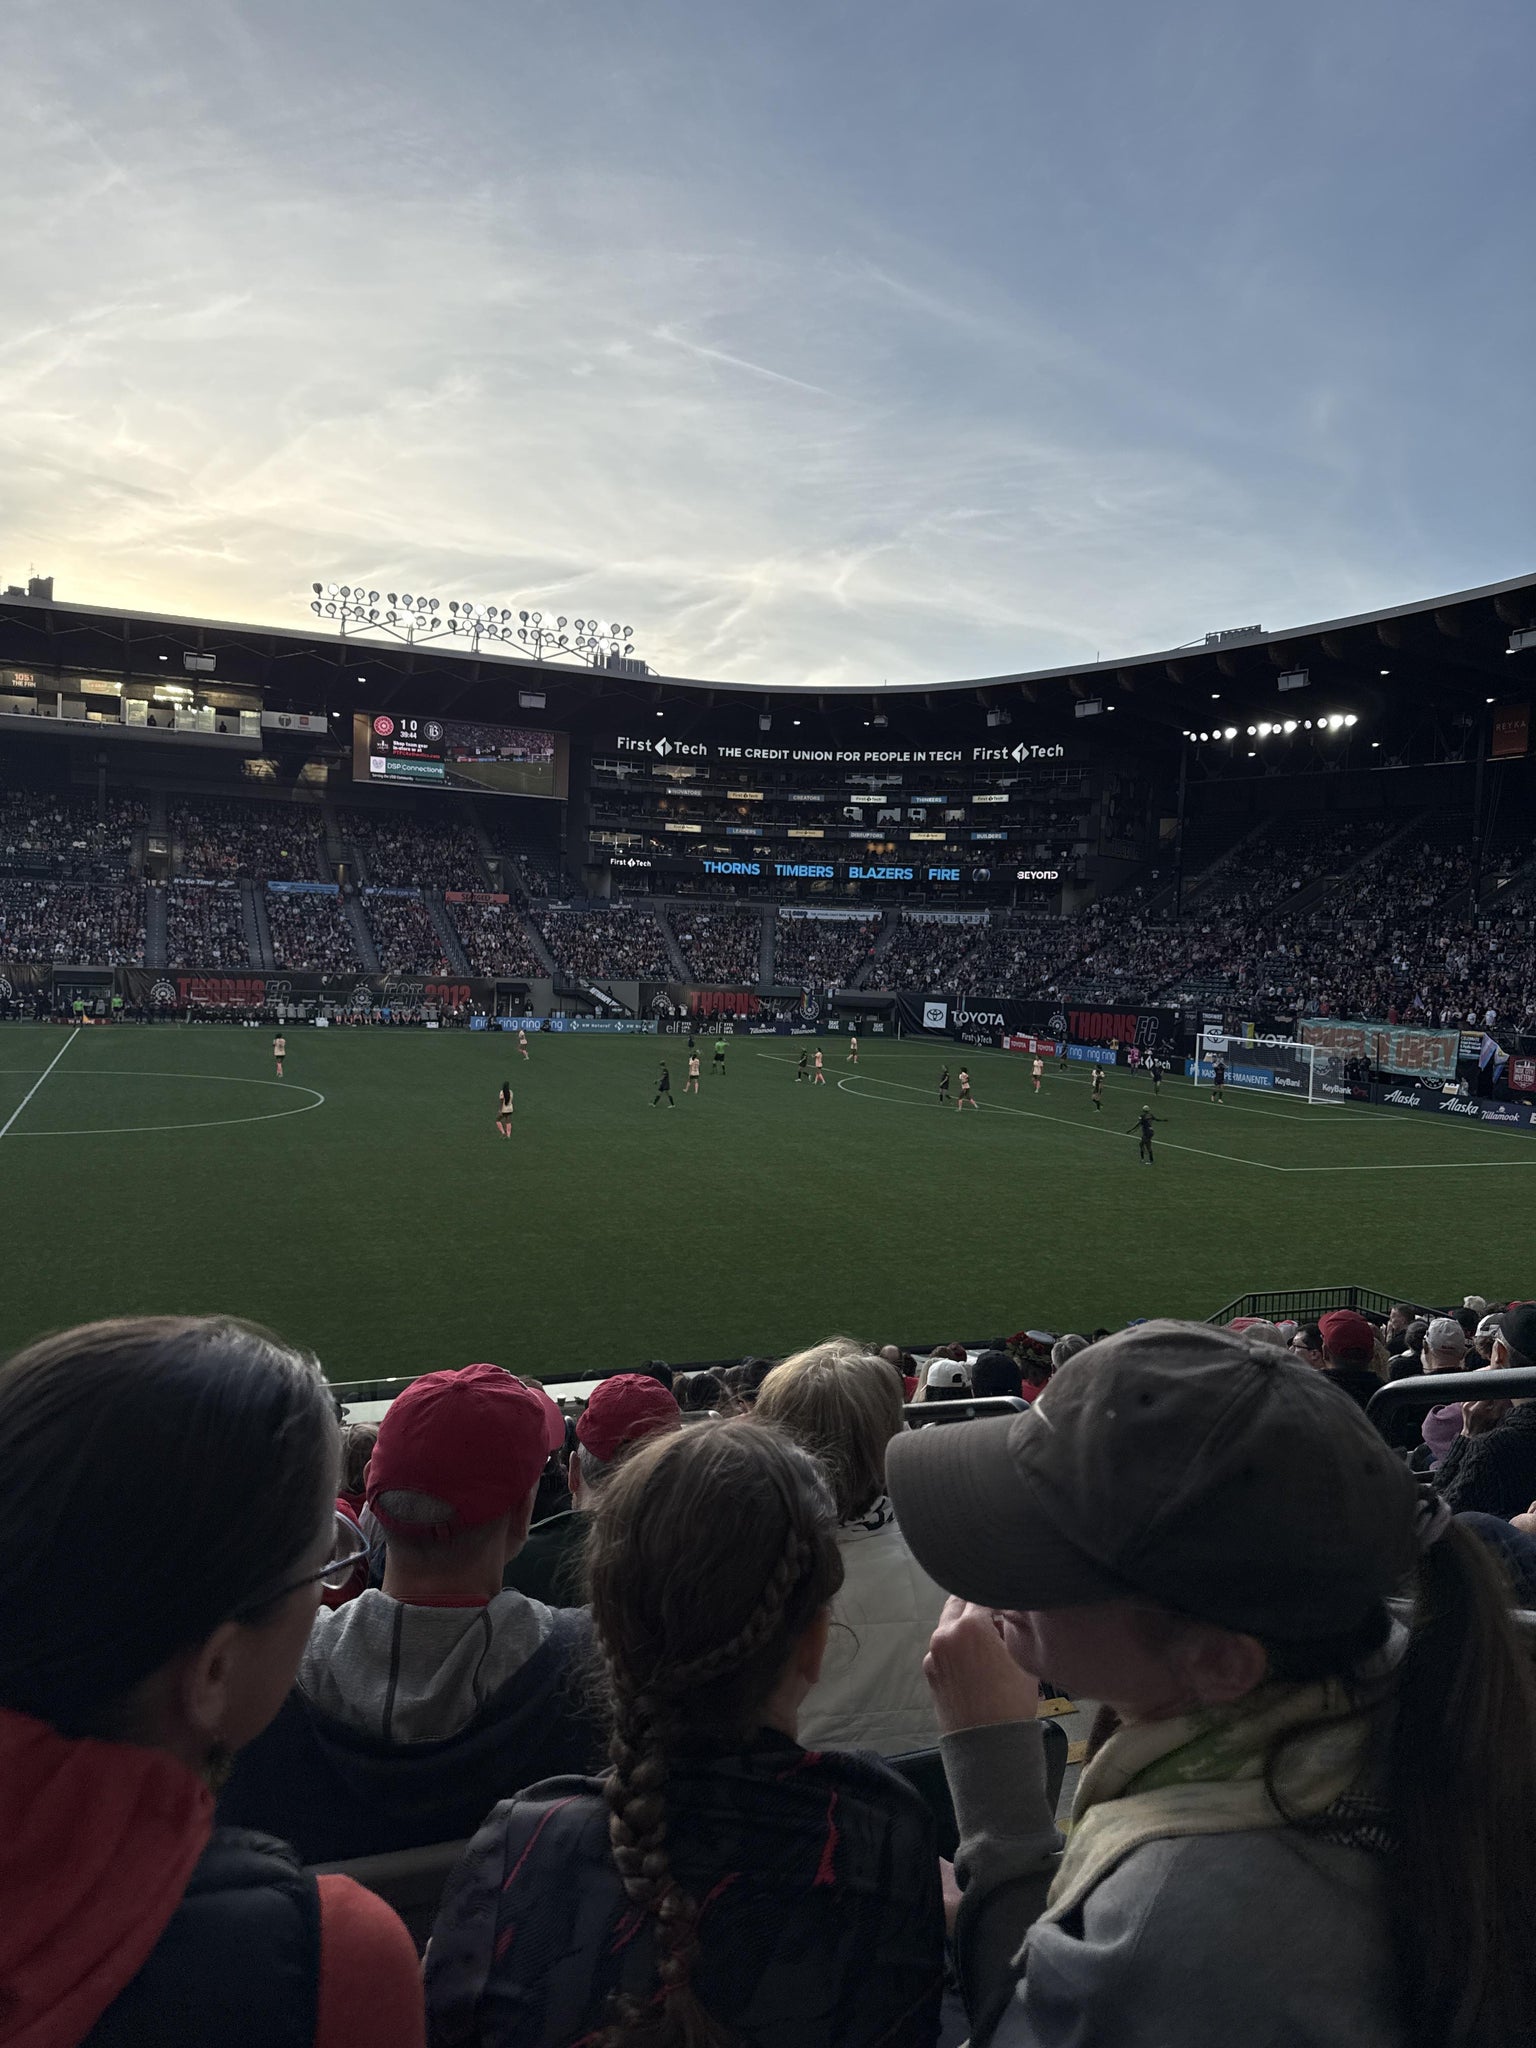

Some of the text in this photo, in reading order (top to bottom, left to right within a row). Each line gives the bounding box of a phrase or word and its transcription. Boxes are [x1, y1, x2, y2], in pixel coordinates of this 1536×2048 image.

[401, 719, 417, 731] 1 0
[617, 736, 708, 756] First Tech
[973, 743, 1064, 761] First Tech
[718, 747, 962, 762] THE CREDIT UNION FOR PEOPLE IN TECH
[387, 762, 443, 774] DSP Connections
[610, 858, 651, 868] First Tech
[703, 861, 961, 881] THORNS TIMBERS BLAZERS FIRE
[1016, 871, 1059, 880] BEYOND
[690, 991, 760, 1016] THORNS
[521, 1018, 540, 1031] ring
[951, 1010, 1005, 1026] TOYOTA
[1068, 1010, 1159, 1047] THORNS FC
[980, 1034, 993, 1044] Tech
[1010, 1040, 1027, 1049] TOYOTA
[1037, 1044, 1054, 1052] TOYOTA
[1069, 1047, 1082, 1059] ring
[1087, 1049, 1101, 1062] ring
[1102, 1051, 1116, 1063] ring
[1201, 1069, 1268, 1086] KAIS PERMANENTE
[1322, 1083, 1352, 1096] KeyBank
[1384, 1090, 1421, 1107] Alaska
[1439, 1098, 1479, 1115] Alaska
[1481, 1110, 1520, 1122] Tillamook
